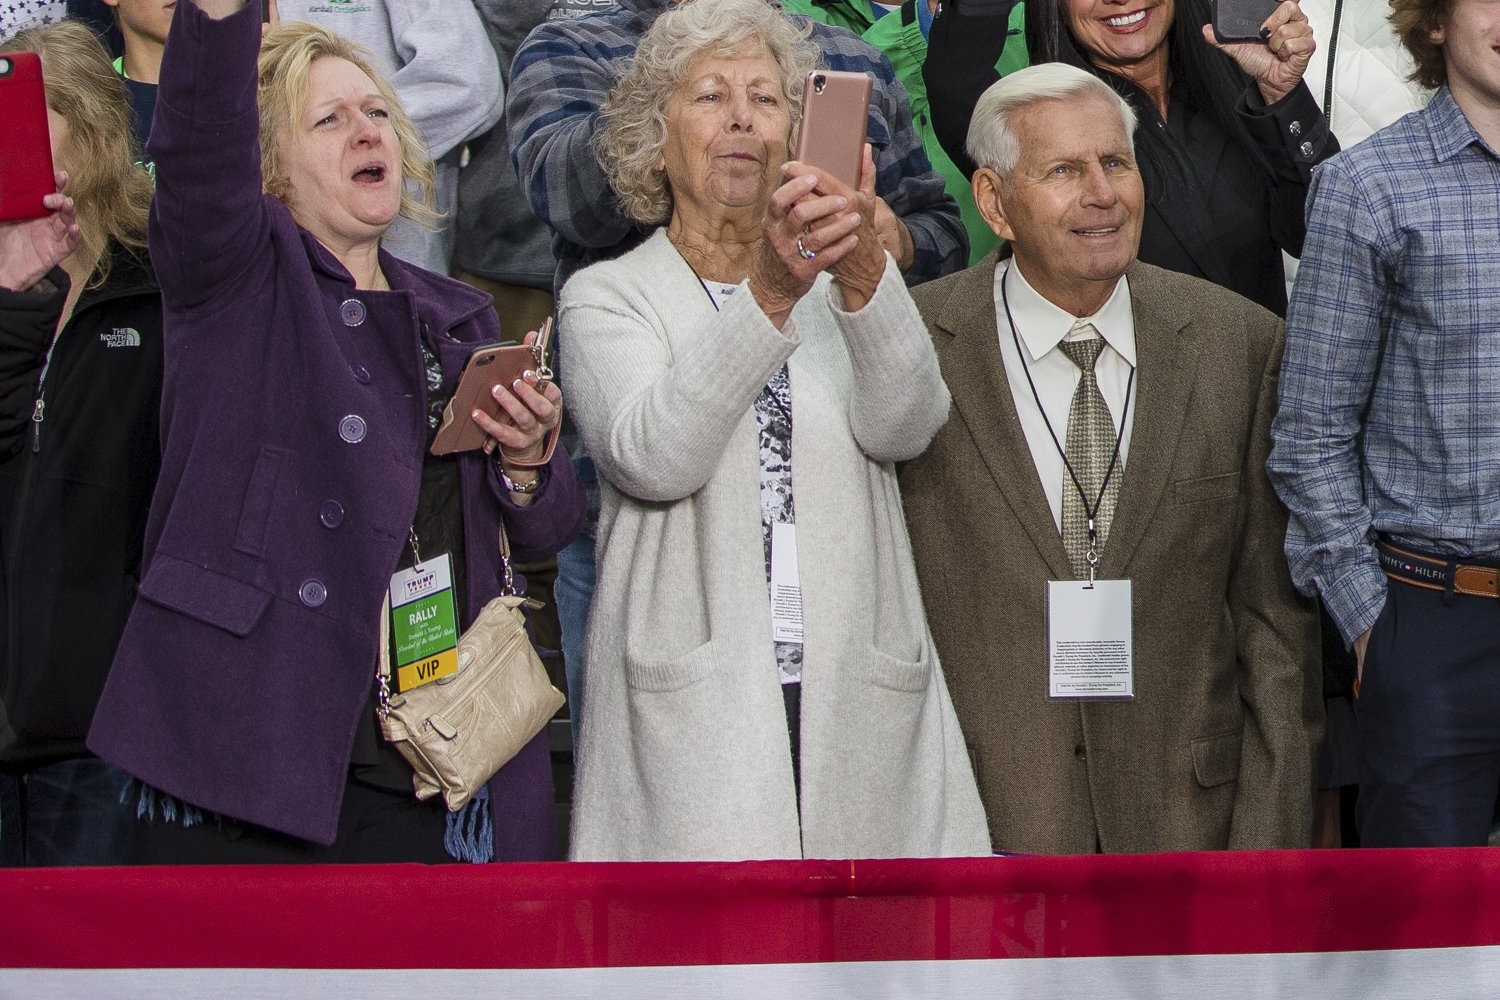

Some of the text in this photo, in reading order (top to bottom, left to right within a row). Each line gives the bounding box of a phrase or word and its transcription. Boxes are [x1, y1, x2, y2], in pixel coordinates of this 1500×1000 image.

[407, 574, 434, 589] TRUMP
[409, 581, 432, 593] PENCE
[409, 605, 438, 626] RALLY
[416, 659, 440, 680] VIP
